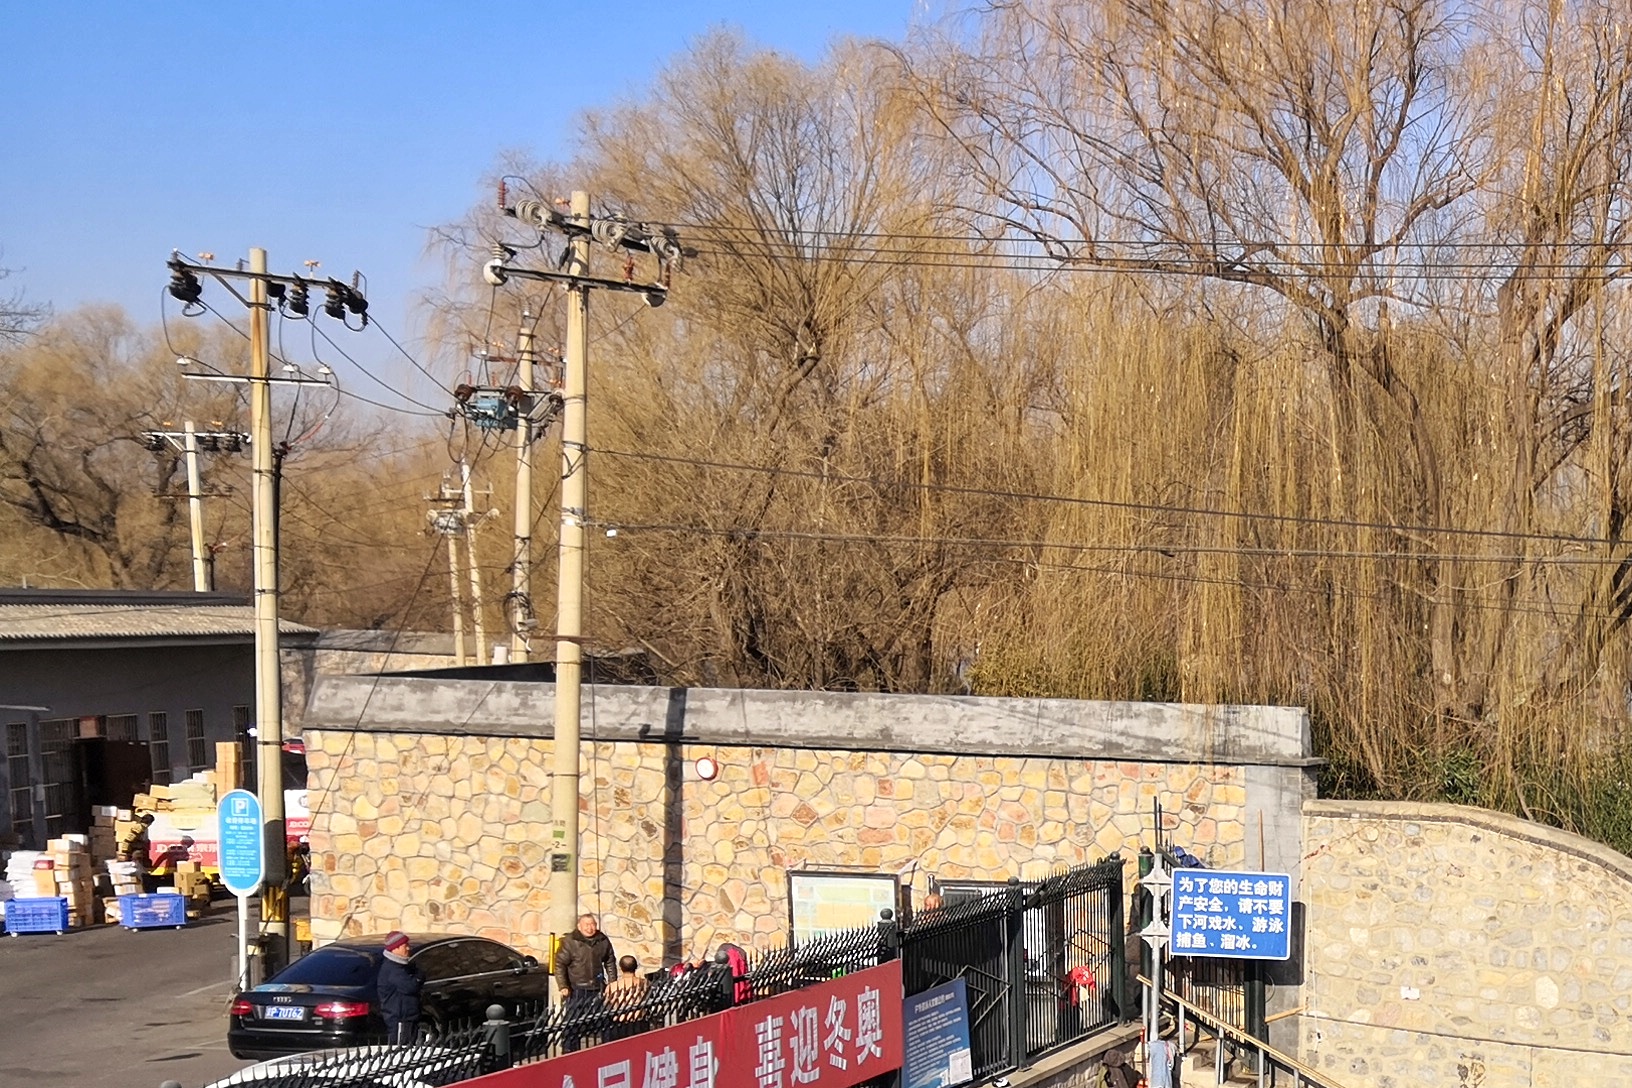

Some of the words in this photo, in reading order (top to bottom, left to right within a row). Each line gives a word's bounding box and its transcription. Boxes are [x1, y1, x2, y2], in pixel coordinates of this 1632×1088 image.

[235, 800, 246, 814] P
[1179, 877, 1284, 897] 为了您的生命财
[1178, 896, 1284, 914] 产安全，请不要
[1177, 914, 1284, 934] 下河戏水、游泳
[1177, 932, 1258, 950] 捕鱼、溜冰。
